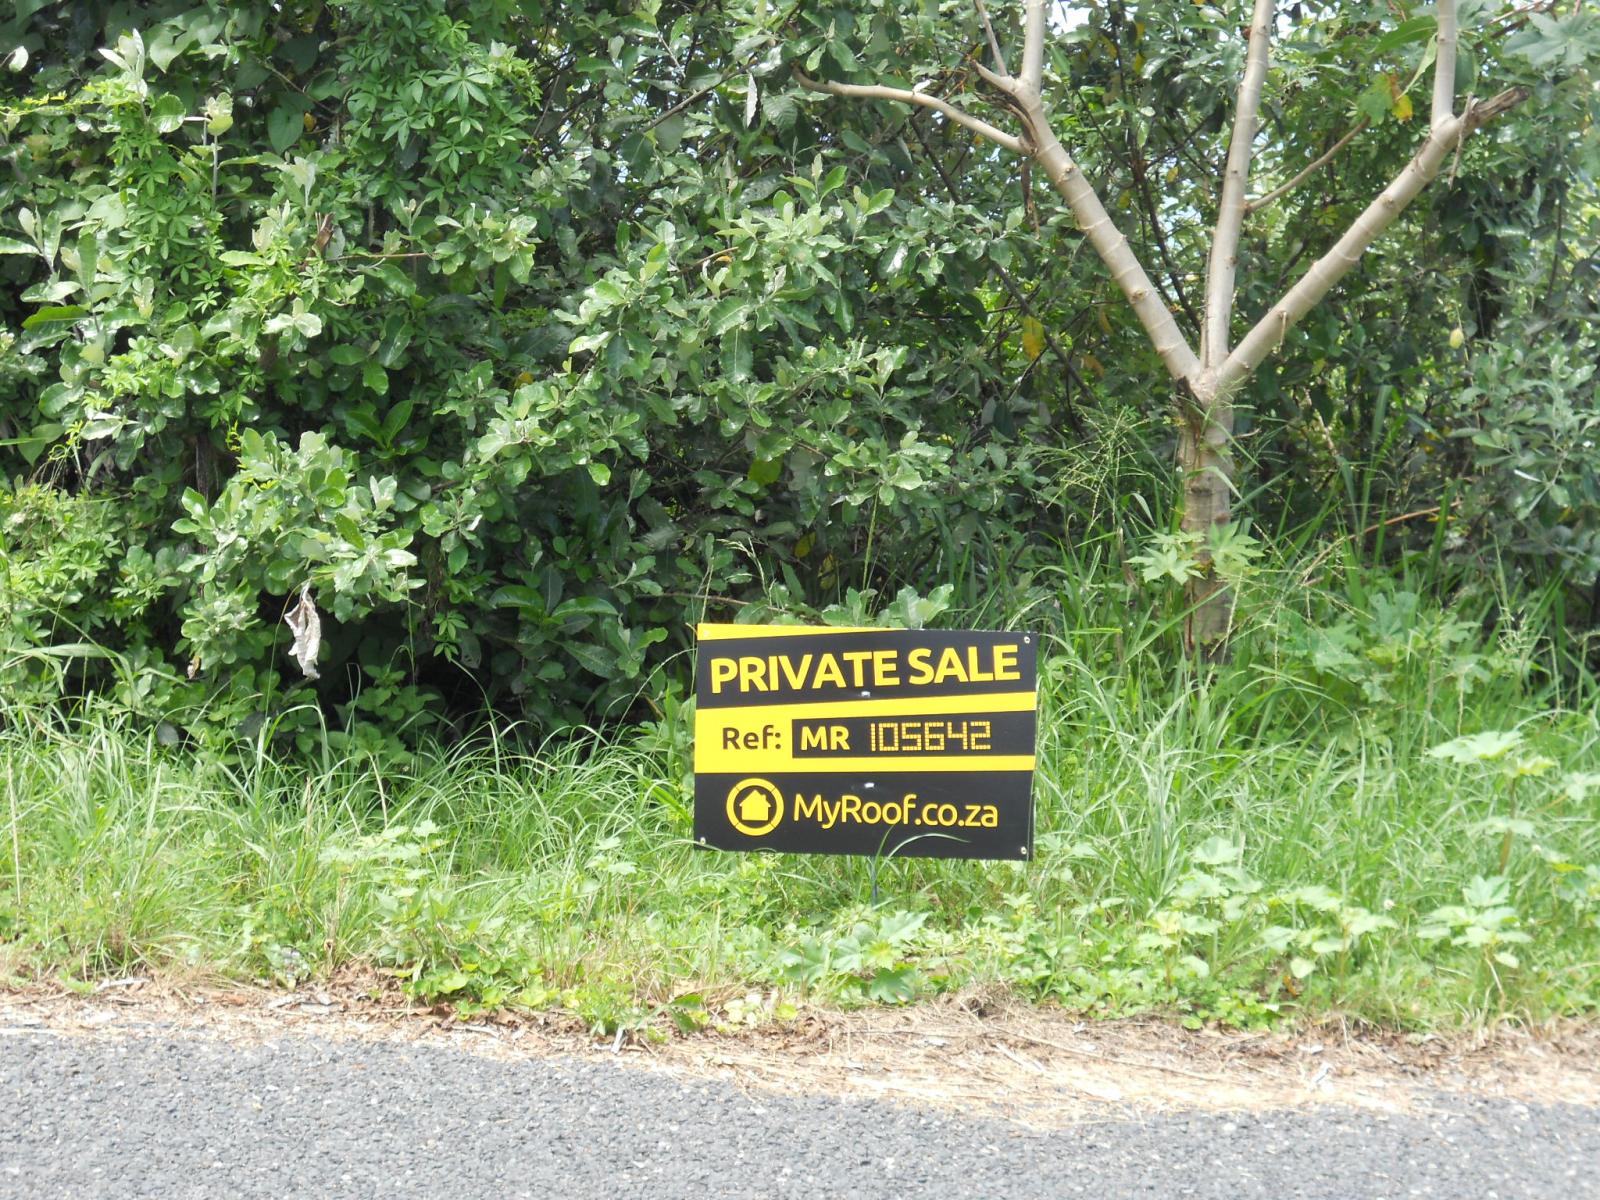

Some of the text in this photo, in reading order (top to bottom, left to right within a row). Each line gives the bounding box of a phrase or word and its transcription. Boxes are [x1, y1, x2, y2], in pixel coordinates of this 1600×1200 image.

[710, 644, 1021, 694] PRIVATE SALE
[722, 721, 991, 752] Ref: MR 105642
[793, 793, 999, 829] MyRoof.co.za
